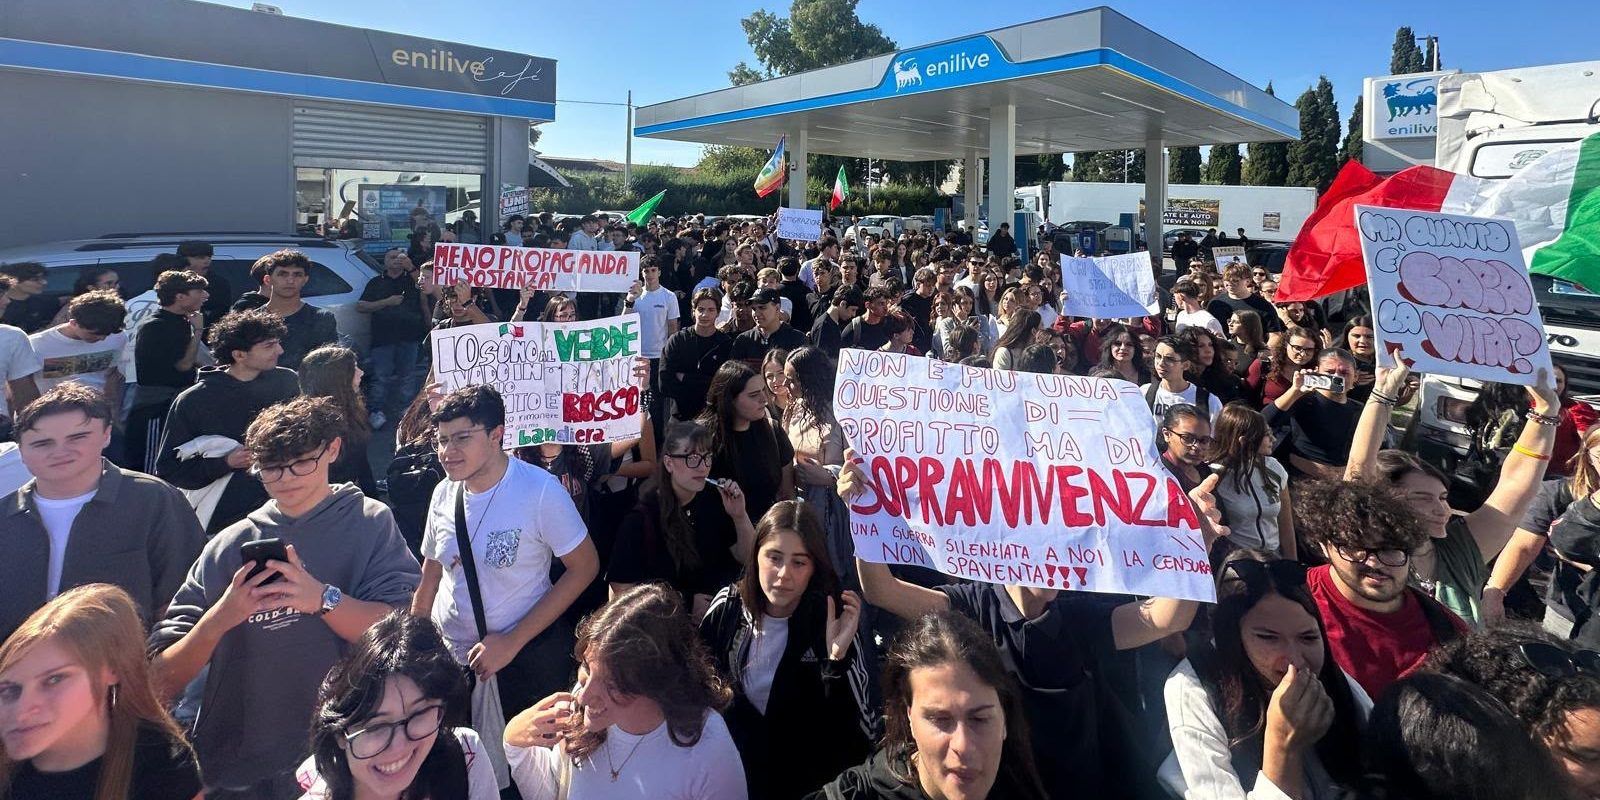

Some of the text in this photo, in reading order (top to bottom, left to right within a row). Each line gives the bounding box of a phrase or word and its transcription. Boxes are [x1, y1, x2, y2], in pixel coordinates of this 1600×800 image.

[391, 49, 542, 95] enilive Café
[926, 52, 990, 77] enilive
[1359, 211, 1511, 252] MA QUANTO
[435, 245, 495, 269] MENO
[463, 267, 557, 290] SOSTANZA!
[1397, 251, 1533, 315] CARA
[438, 320, 638, 374] IO SONO AL VERDE
[1378, 298, 1542, 374] LA VITA?
[453, 363, 509, 390] VADO
[513, 363, 543, 381] IN
[840, 350, 907, 378] NON
[1036, 374, 1118, 400] UNA
[518, 411, 560, 421] rimanere
[562, 385, 640, 423] ROSSO
[838, 379, 1059, 425] QUESTIONE DI
[518, 426, 605, 446] bandiera
[838, 417, 1144, 467] PROFITTO MA DI
[851, 522, 879, 537] UNA
[892, 525, 936, 549] GUERRA
[1046, 546, 1059, 562] A
[1067, 544, 1105, 567] NOI
[1123, 550, 1145, 568] LA
[1152, 554, 1213, 576] CENSURA
[882, 542, 1088, 590] NON SPAVENTA!!!
[248, 609, 281, 624] COLD
